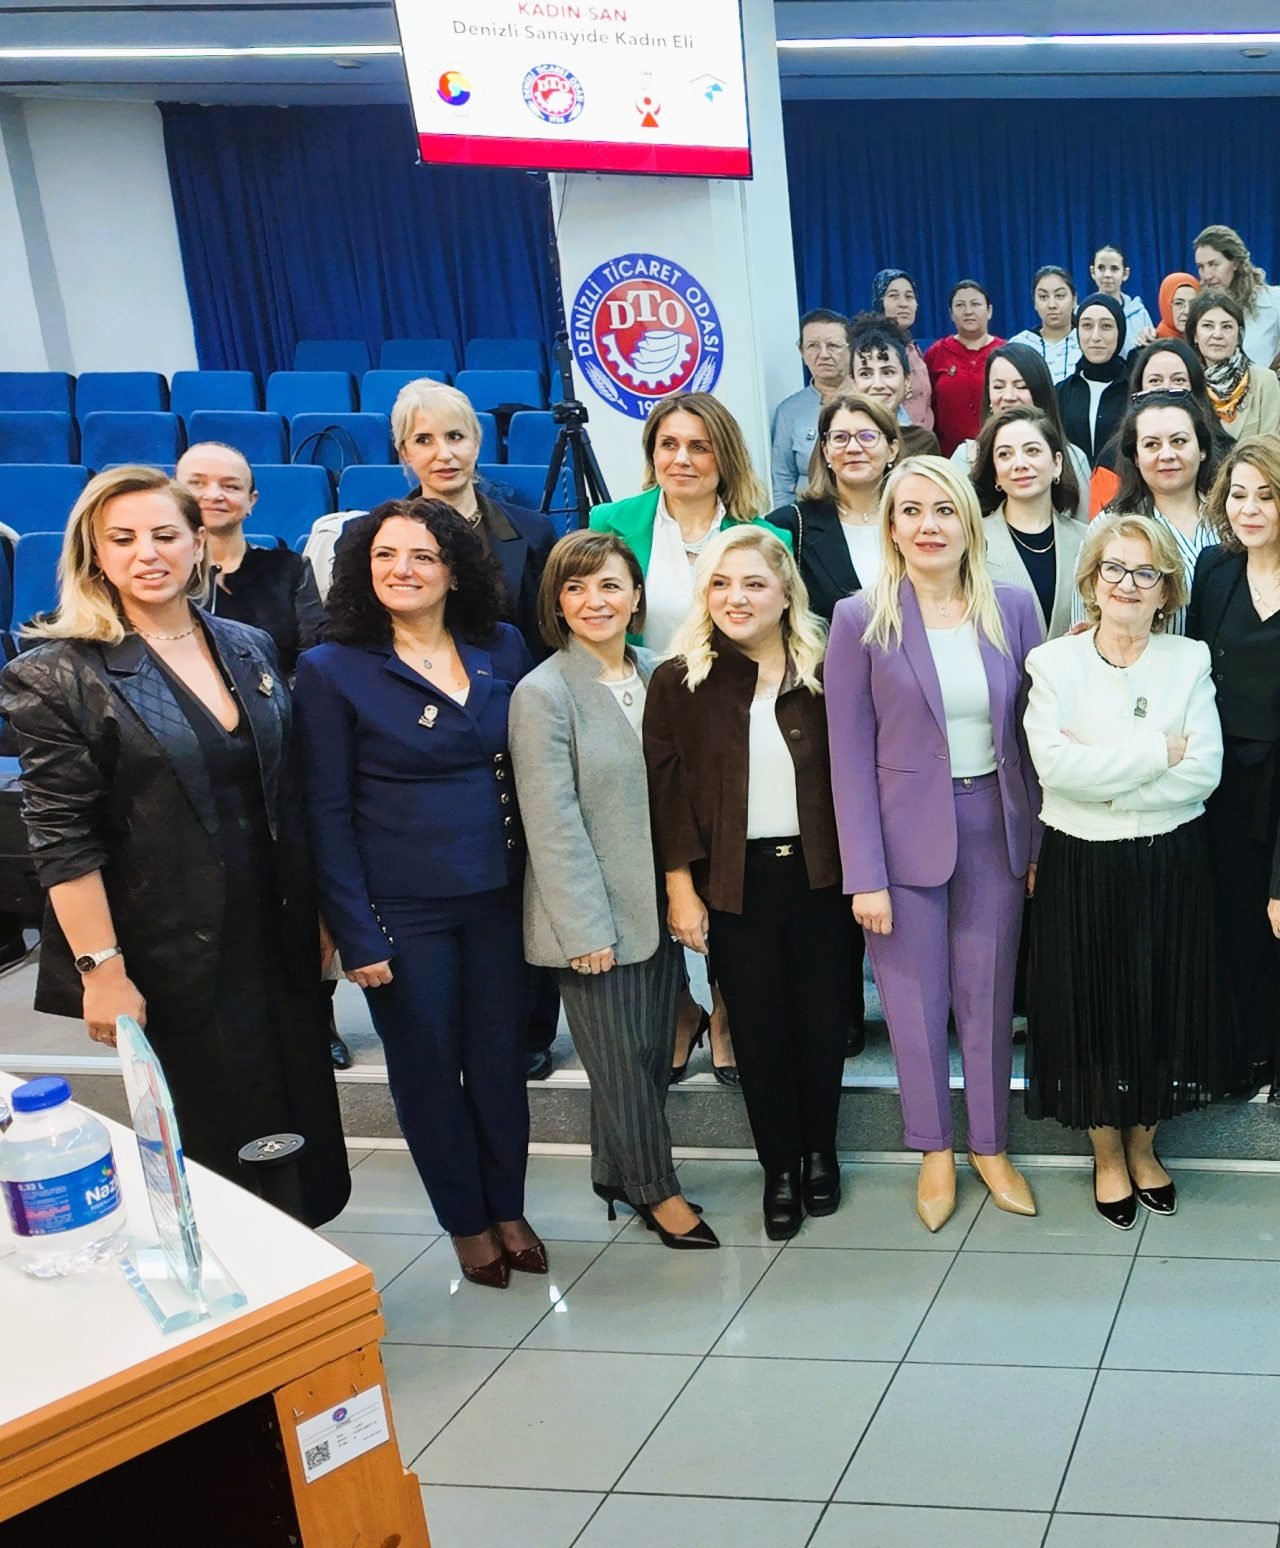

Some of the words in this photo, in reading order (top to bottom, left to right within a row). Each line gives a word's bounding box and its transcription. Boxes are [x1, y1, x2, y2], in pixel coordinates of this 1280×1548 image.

[518, 2, 581, 19] KADIN
[588, 7, 627, 22] SAN
[452, 20, 519, 38] Denizli
[524, 25, 609, 46] Sanayide
[615, 31, 667, 48] Kadın
[672, 34, 694, 49] Eli
[575, 278, 603, 357] DENİZLİ
[602, 259, 683, 286] TİCARET
[686, 287, 720, 353] ODASI
[606, 290, 686, 330] DTO
[637, 400, 661, 416] 19
[85, 1176, 118, 1206] Naz
